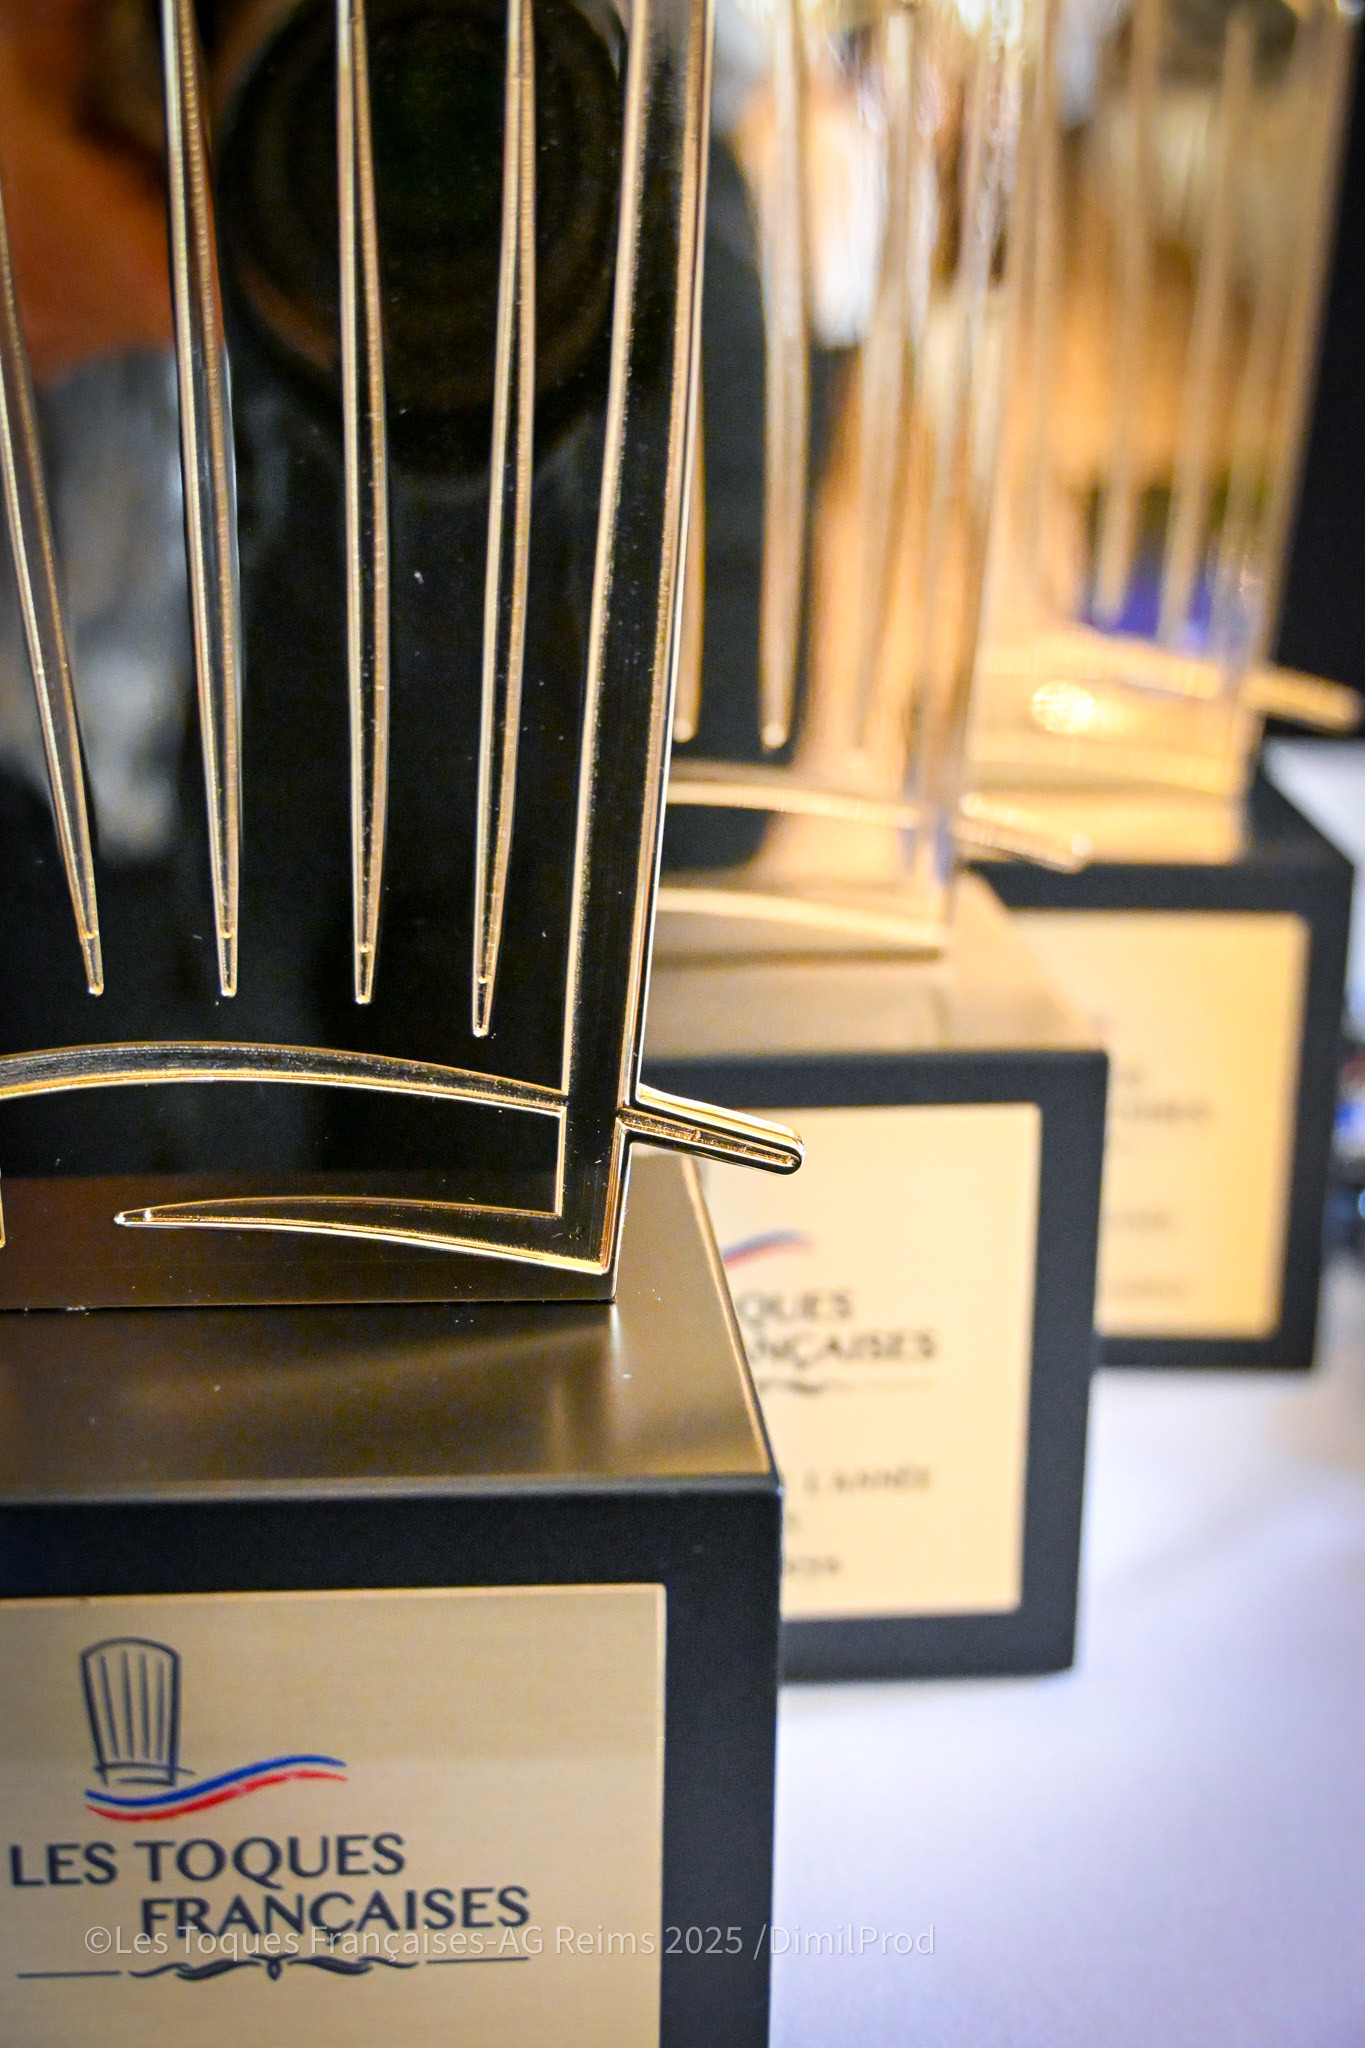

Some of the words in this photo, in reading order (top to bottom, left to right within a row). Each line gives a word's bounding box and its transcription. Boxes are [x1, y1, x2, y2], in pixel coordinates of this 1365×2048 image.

[10, 1841, 118, 1886] LES
[133, 1832, 406, 1890] TOQUES
[140, 1885, 530, 1945] FRANÇAISES
